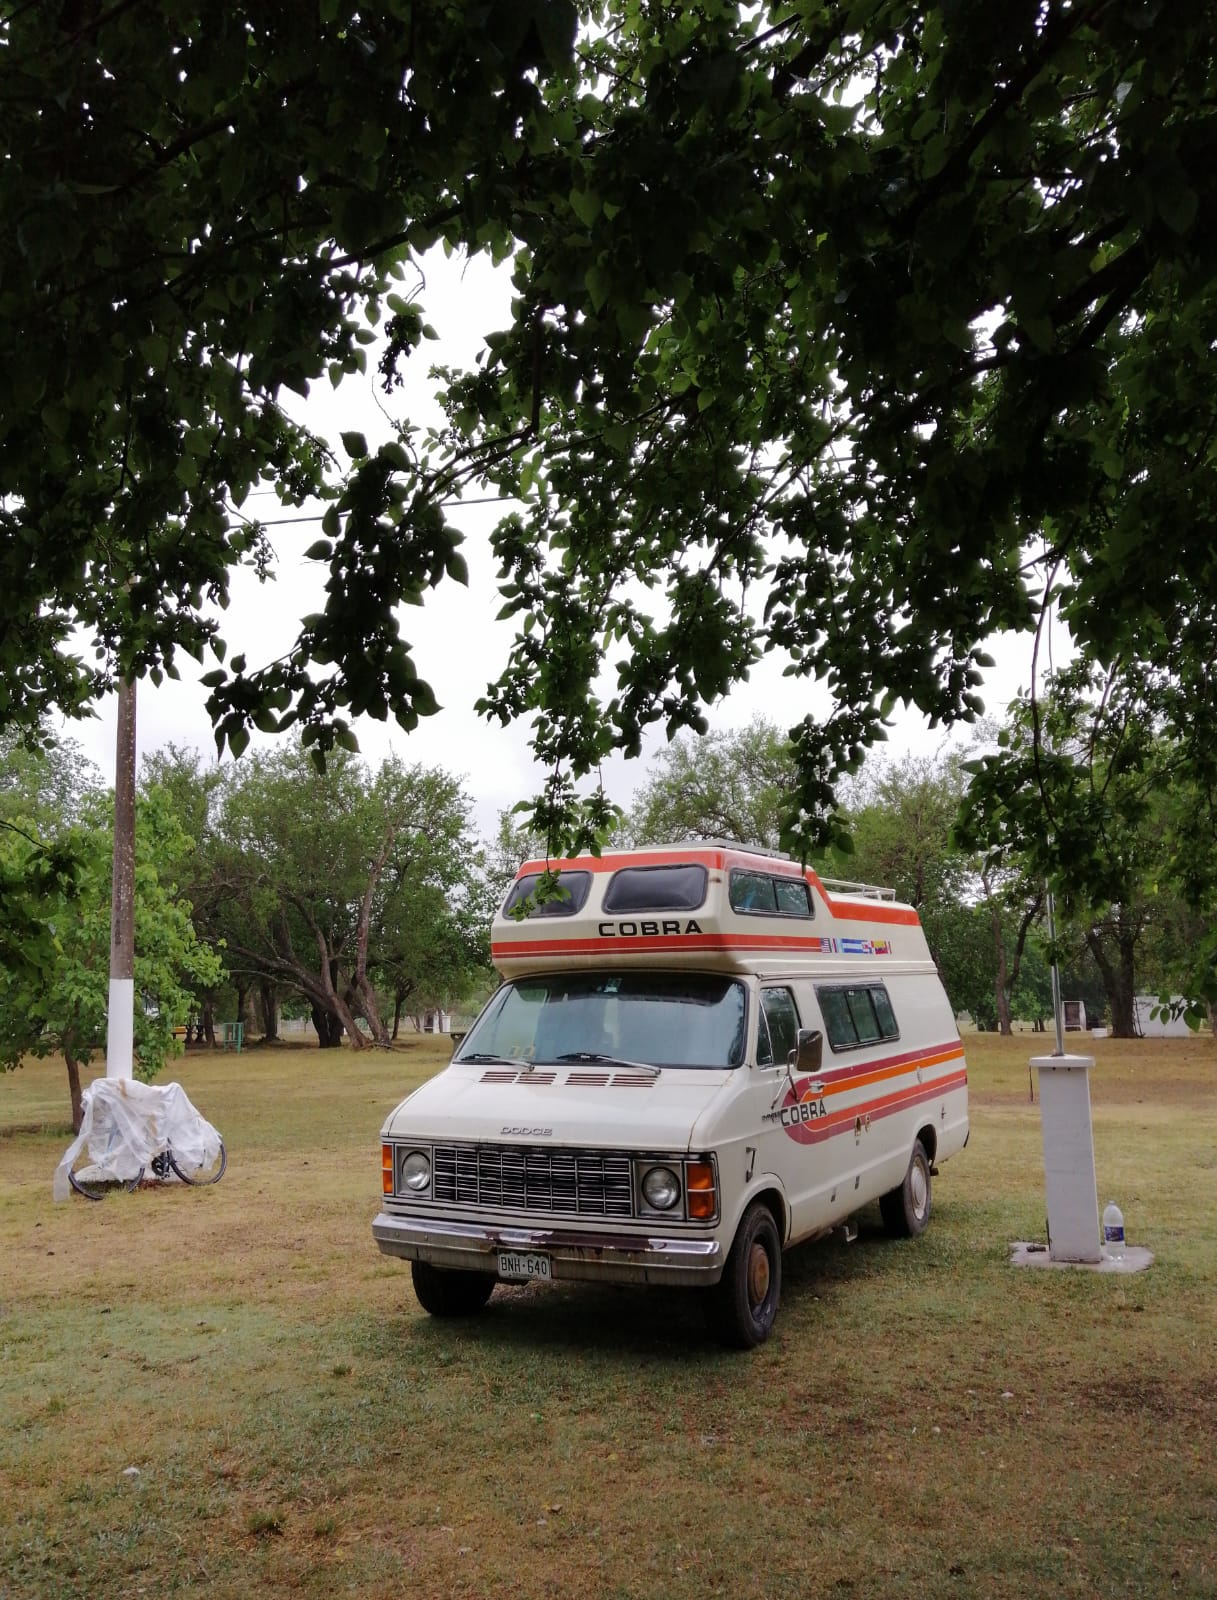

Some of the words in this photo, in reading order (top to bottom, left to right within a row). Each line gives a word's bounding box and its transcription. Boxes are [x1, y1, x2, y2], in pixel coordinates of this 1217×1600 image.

[599, 919, 703, 937] COBRA
[780, 1099, 827, 1127] COBRA
[500, 1127, 553, 1137] DODGE
